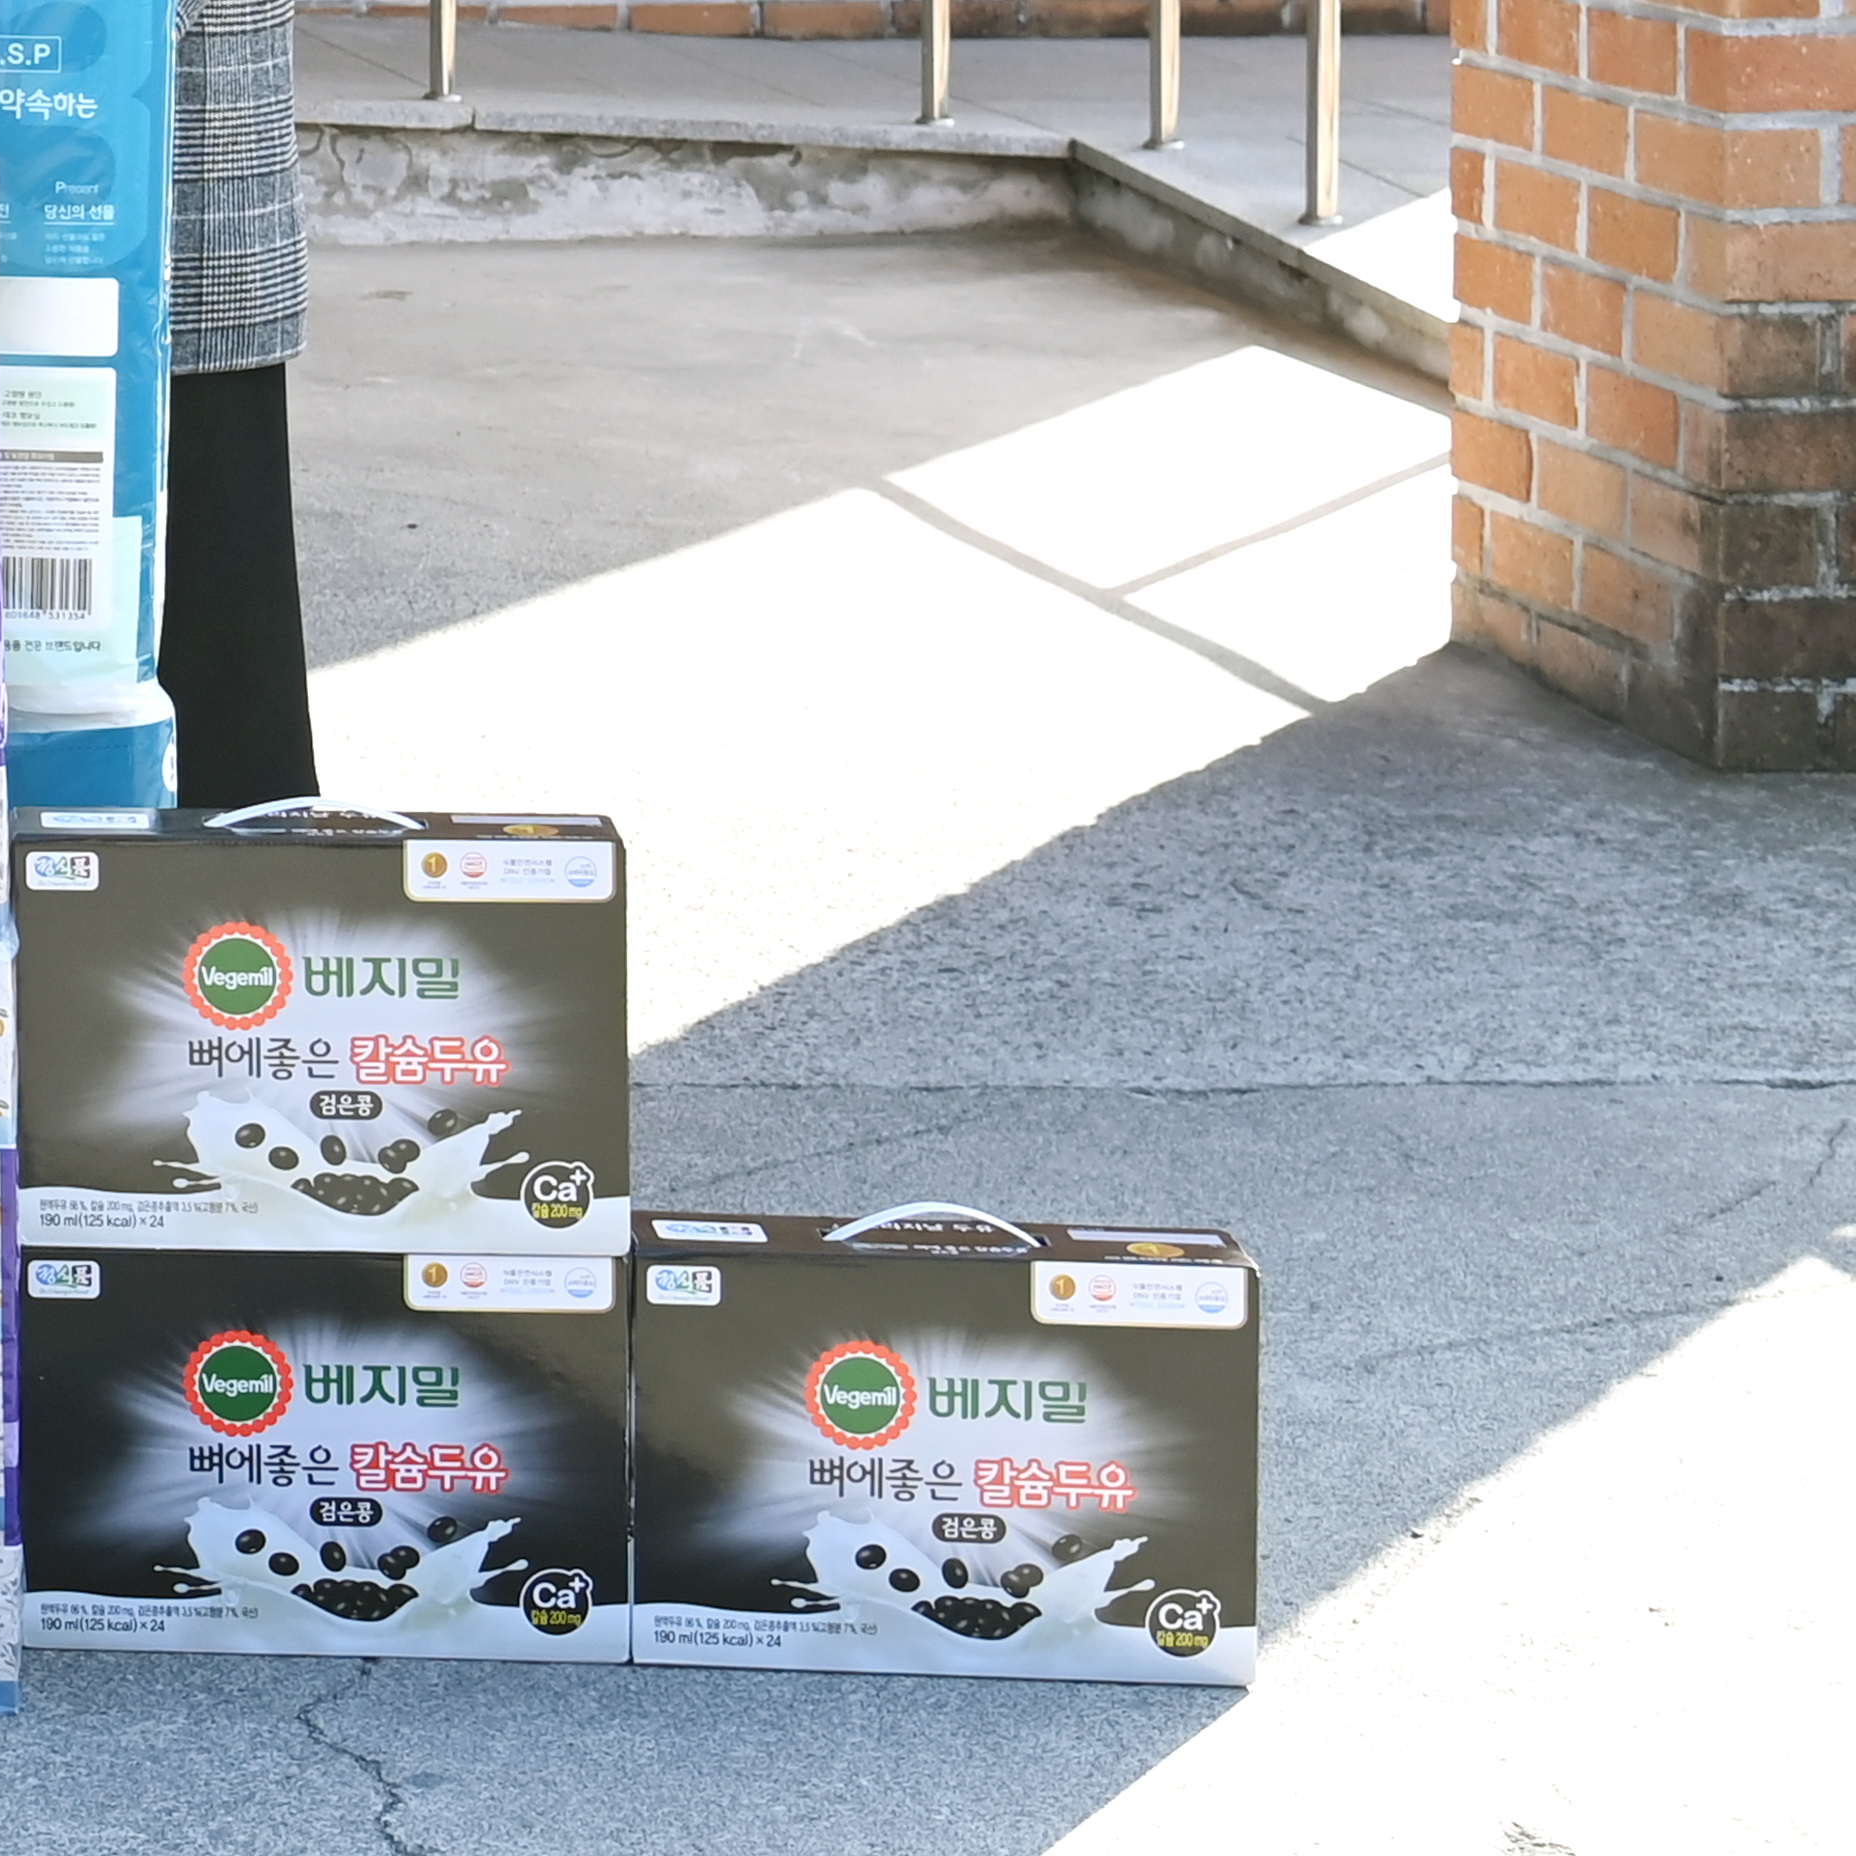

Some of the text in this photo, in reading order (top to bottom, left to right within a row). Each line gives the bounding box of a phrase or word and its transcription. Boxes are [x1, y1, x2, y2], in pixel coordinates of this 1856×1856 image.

[44, 204, 115, 220] 당신의 선물
[201, 966, 274, 991] Vegemil
[302, 955, 460, 1000] 베지밀
[188, 1034, 508, 1085] 뼈에좋은 칼슘두유
[318, 1093, 374, 1118] 검은콩
[39, 1212, 60, 1226] 190
[202, 1373, 274, 1399] Vegemil
[302, 1363, 460, 1408] 베지밀
[824, 1384, 897, 1411] Vegemil
[926, 1376, 1088, 1424] 베지밀
[188, 1442, 508, 1493] 뼈에좋은 칼슘두유
[808, 1454, 1135, 1512] 뼈에좋은 칼슘두유
[318, 1500, 374, 1524] 검은콩
[940, 1515, 998, 1541] 검은콩
[41, 1616, 62, 1630] 190
[654, 1629, 677, 1644] 190
